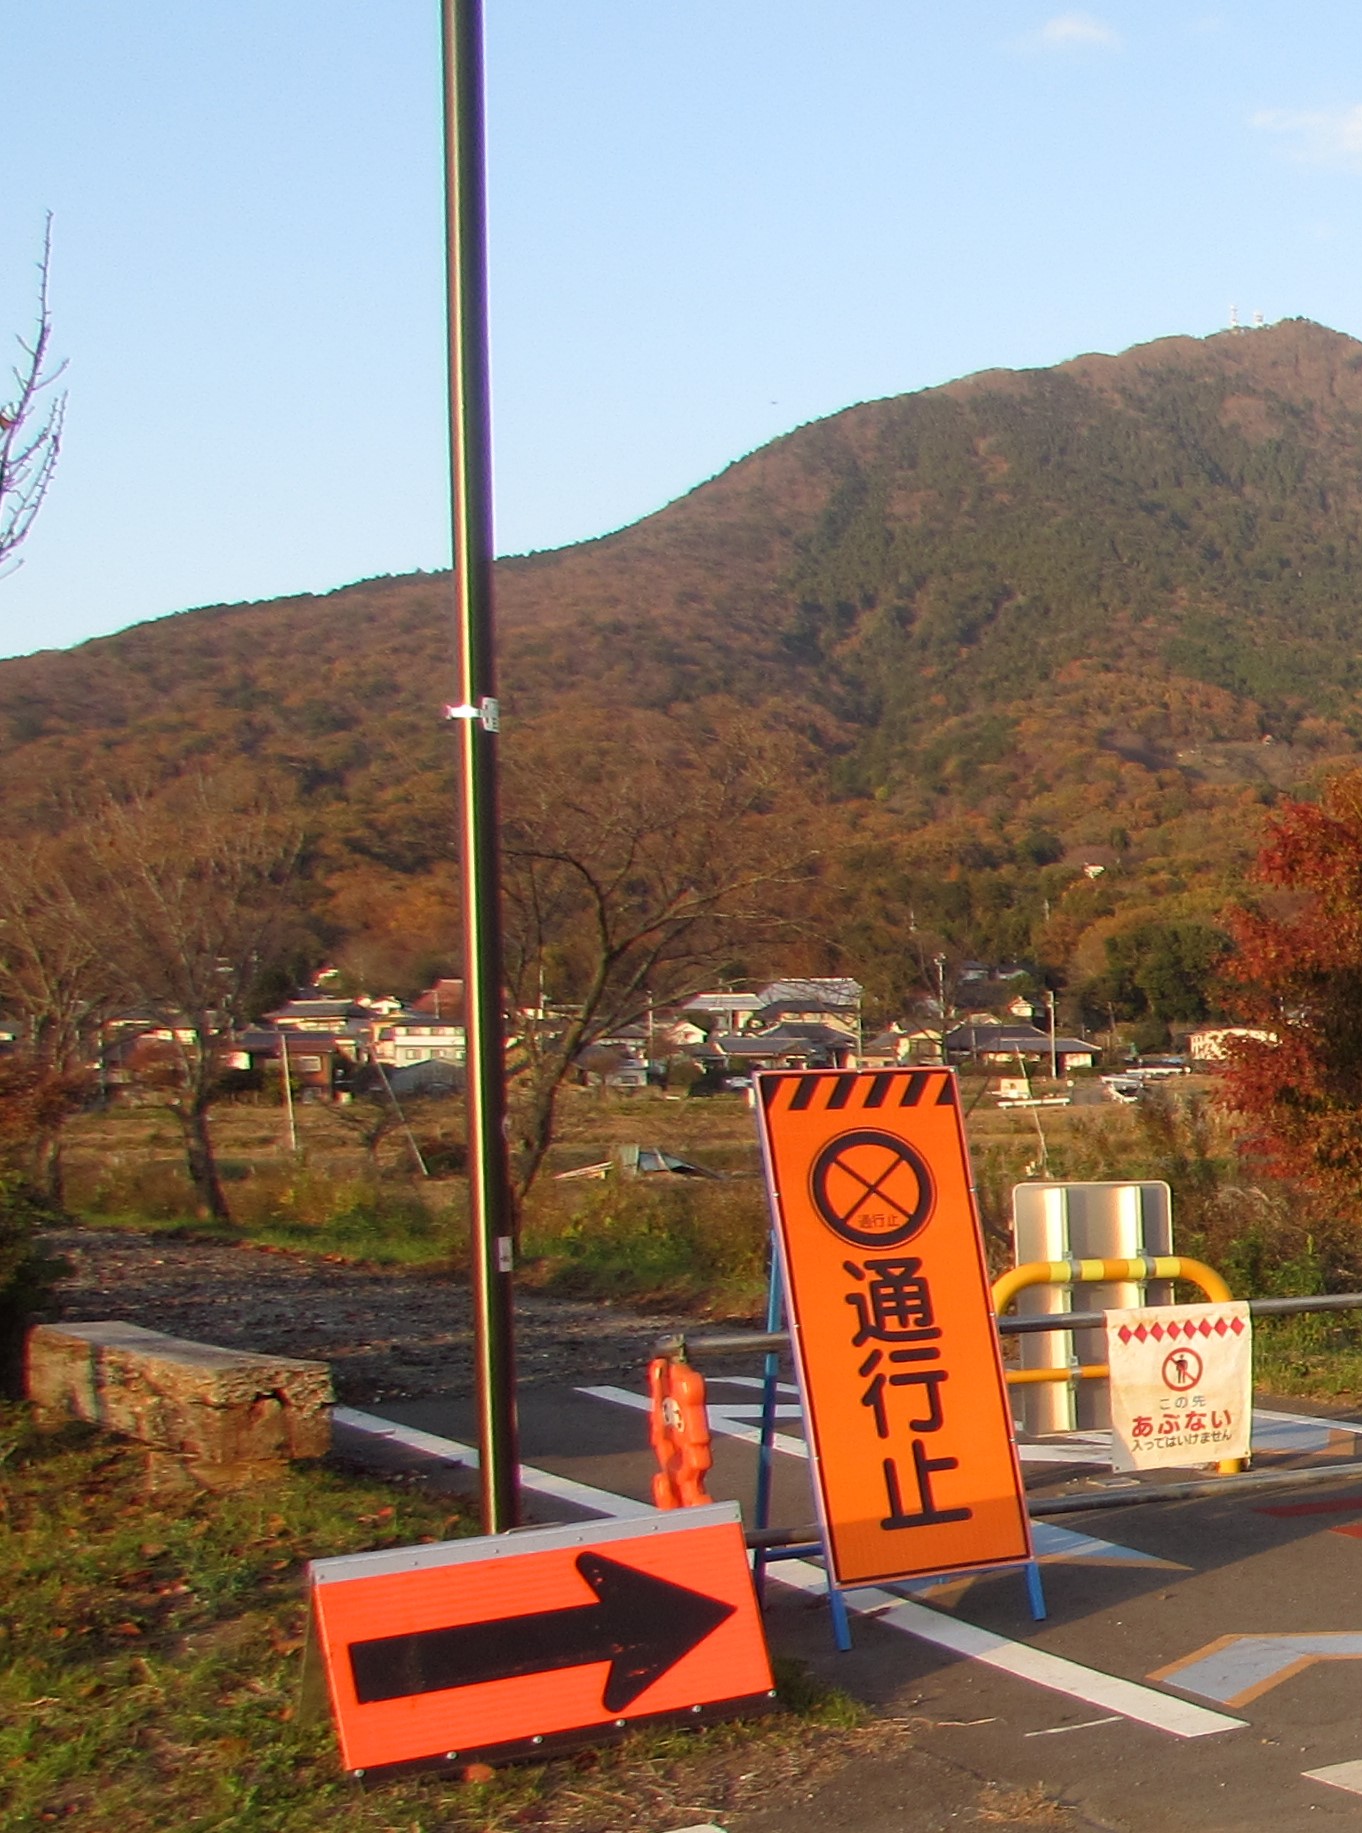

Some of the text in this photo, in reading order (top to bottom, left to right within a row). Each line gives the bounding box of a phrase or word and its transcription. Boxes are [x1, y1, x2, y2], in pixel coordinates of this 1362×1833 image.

[858, 1213, 900, 1229] 通行止
[842, 1257, 973, 1531] 通行止
[1159, 1395, 1207, 1411] この先
[1132, 1409, 1232, 1438] あぶない
[1131, 1429, 1232, 1452] 入ってはいけません
